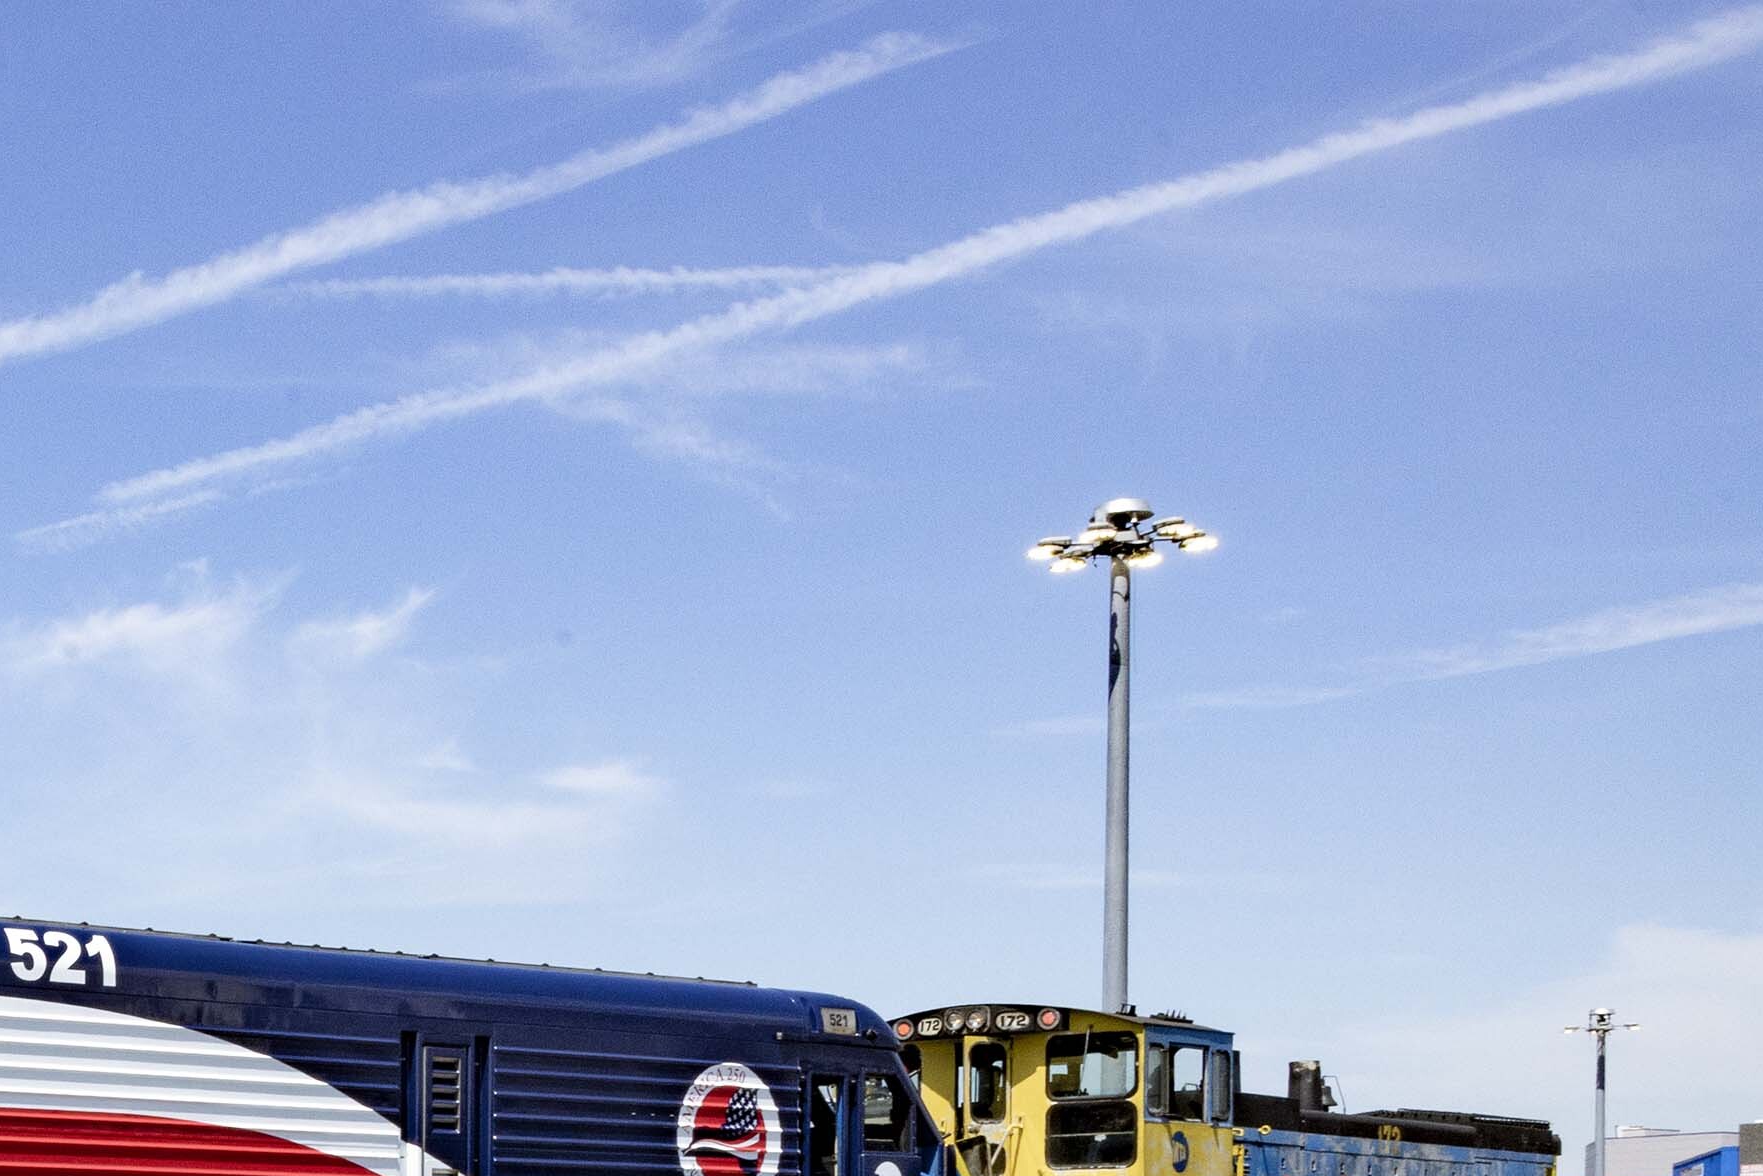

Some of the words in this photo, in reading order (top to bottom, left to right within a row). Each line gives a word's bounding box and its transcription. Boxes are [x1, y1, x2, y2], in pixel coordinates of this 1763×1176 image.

[3, 927, 117, 988] 521
[829, 1012, 849, 1028] 521
[920, 1019, 941, 1032] 172
[999, 1013, 1030, 1026] 172
[682, 1067, 724, 1136] AMERICA
[727, 1067, 747, 1084] 250
